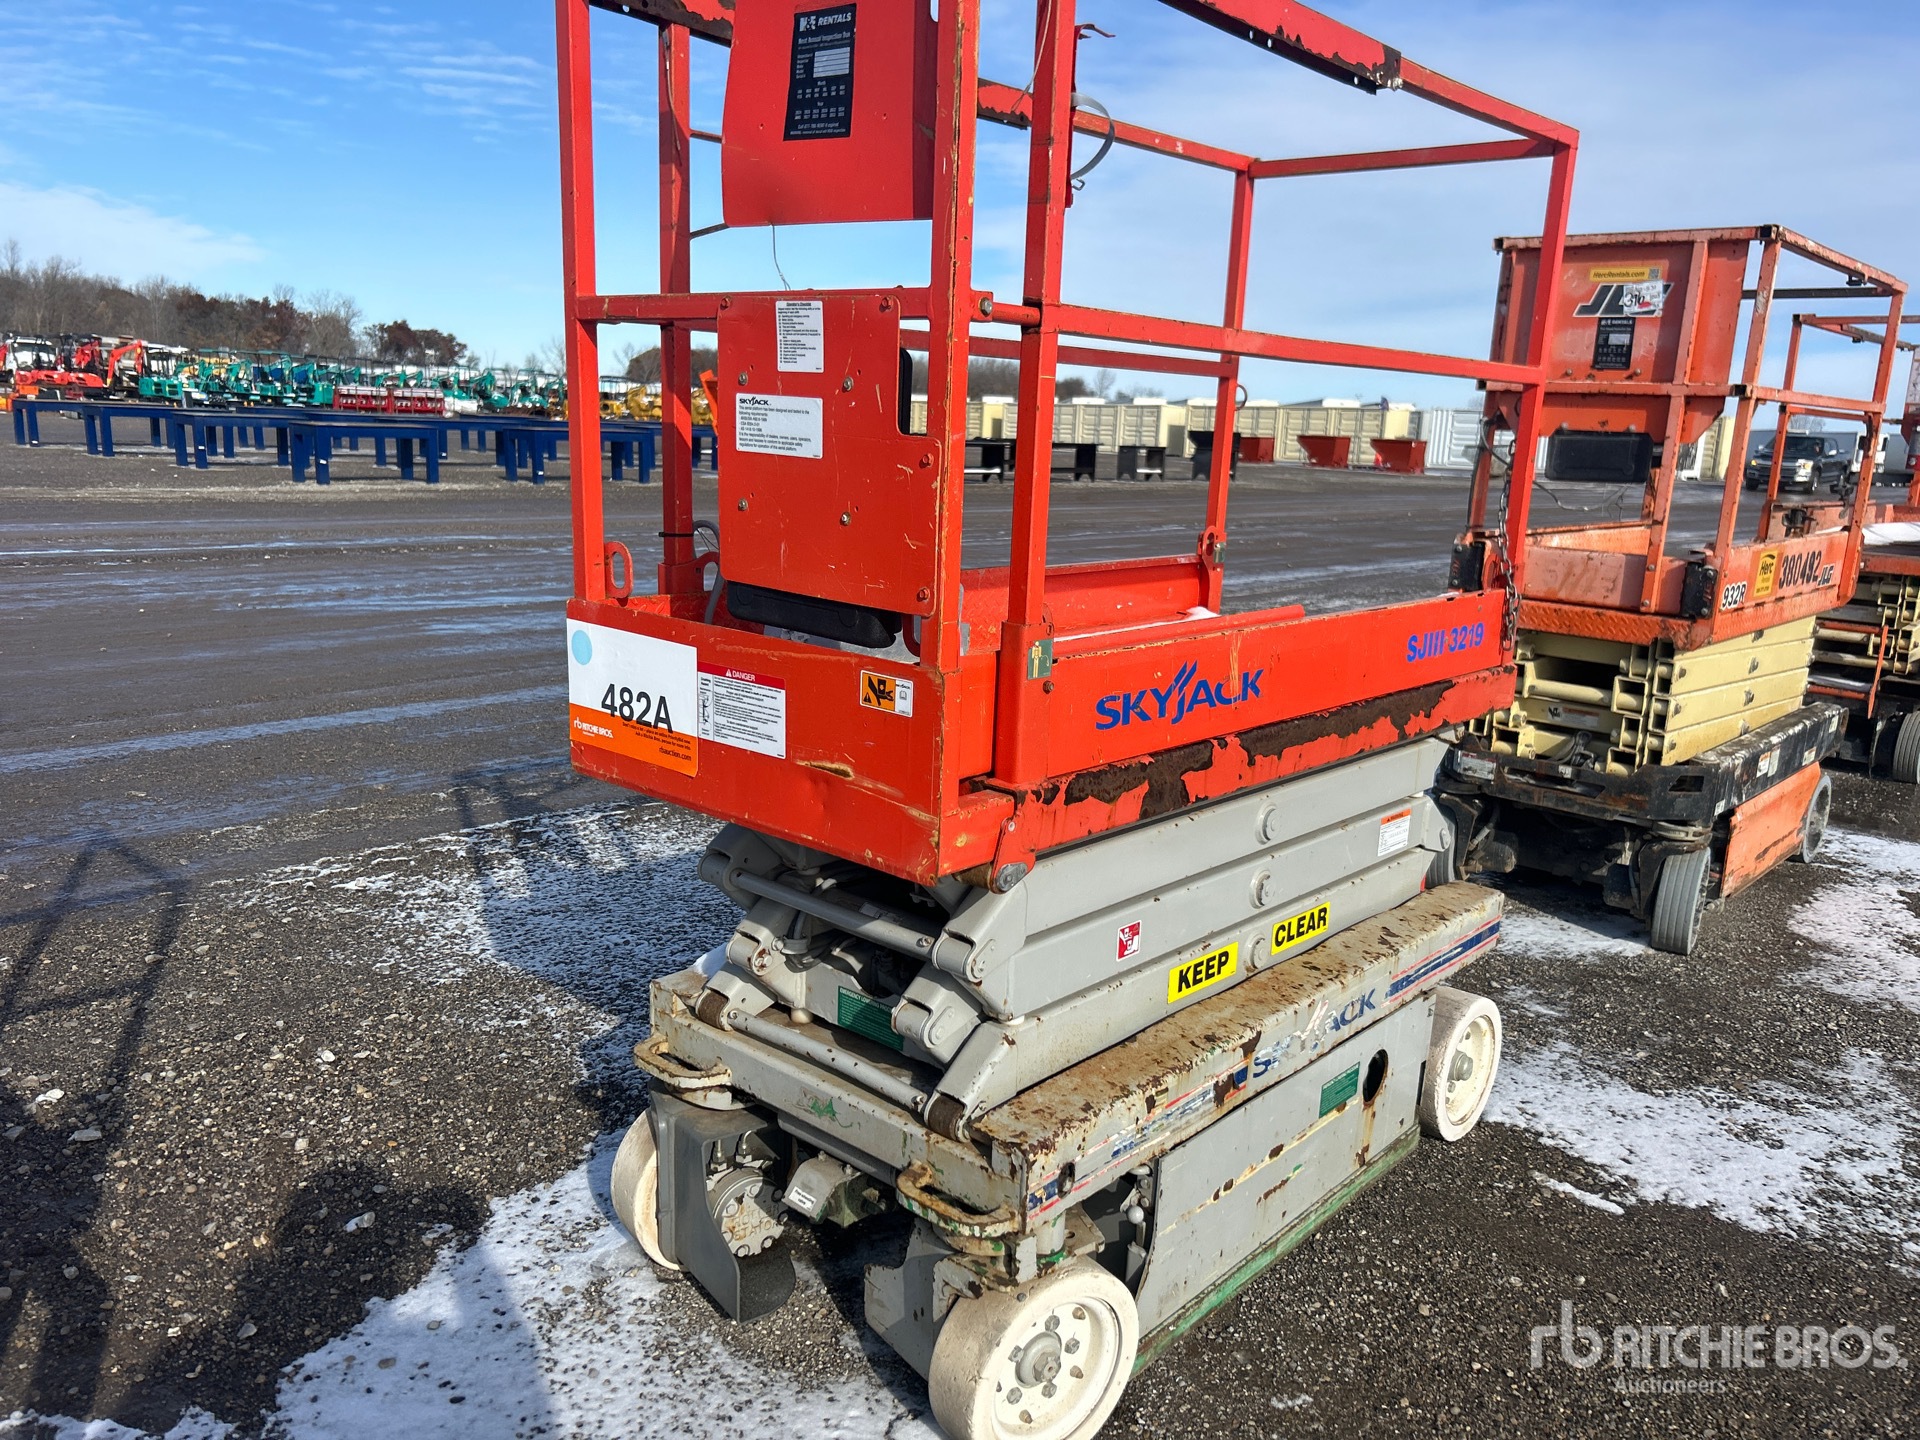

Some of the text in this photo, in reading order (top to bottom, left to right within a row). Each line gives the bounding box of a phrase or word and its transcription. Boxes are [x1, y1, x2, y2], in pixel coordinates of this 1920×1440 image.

[818, 12, 852, 26] RENTALS
[740, 396, 769, 406] SKYJACK
[1759, 560, 1774, 576] Herc
[1779, 550, 1822, 590] 380492
[1722, 583, 1746, 608] 932R
[1406, 622, 1484, 662] SJIII 3219
[732, 670, 756, 682] DANGER
[1095, 661, 1264, 730] SKYJACK
[601, 683, 673, 734] 482A
[582, 722, 598, 734] RITCHIE
[659, 746, 692, 761] rbauction.com
[1274, 907, 1328, 948] CLEAR
[1178, 950, 1229, 993] KEEP
